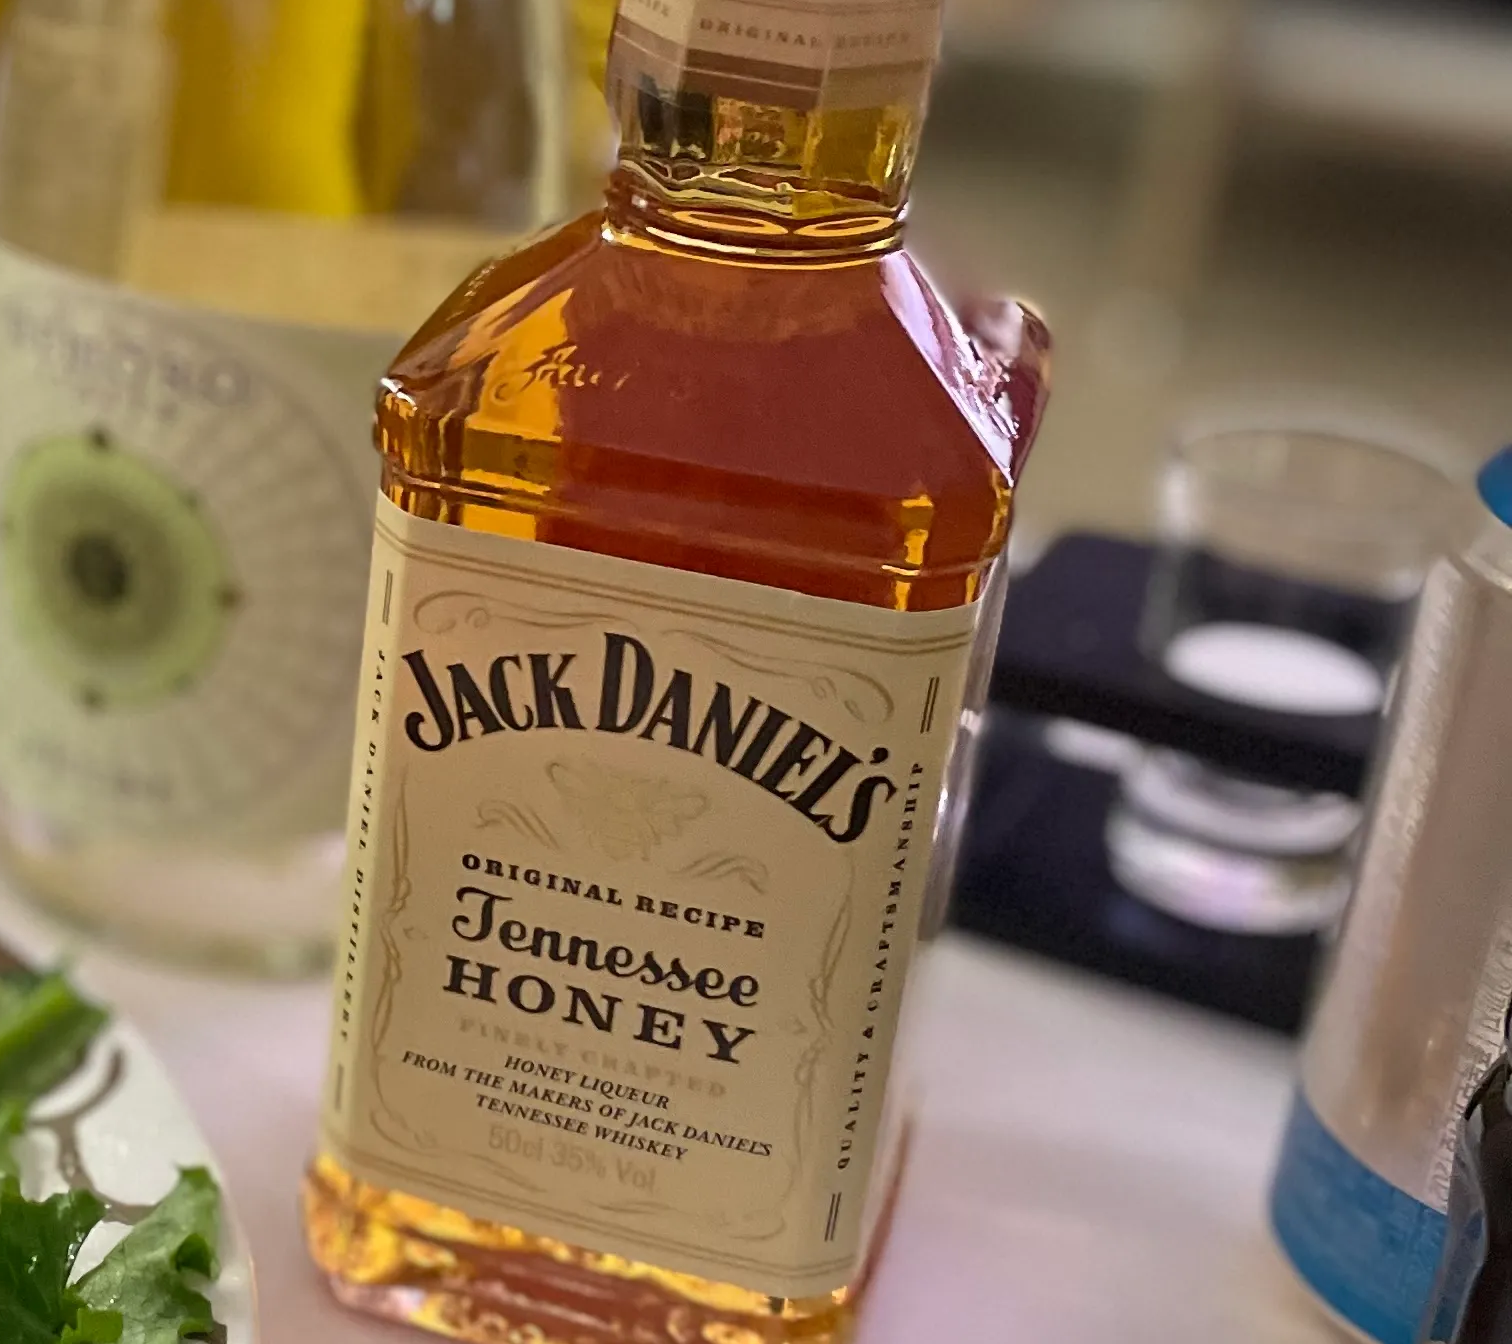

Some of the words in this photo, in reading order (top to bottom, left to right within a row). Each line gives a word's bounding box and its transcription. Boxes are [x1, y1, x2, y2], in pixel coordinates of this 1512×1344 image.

[402, 648, 587, 752] JACK
[594, 630, 898, 845] DANIEL'S
[461, 853, 622, 906] ORIGINAL
[634, 893, 765, 939] RECIPE
[451, 885, 760, 1008] Tennessee
[441, 953, 756, 1066] HONEY
[401, 1049, 457, 1078] FROM
[463, 1067, 504, 1091] THE
[507, 1080, 593, 1113] MAKERS
[597, 1103, 627, 1121] OF
[624, 1111, 681, 1137] JACK
[474, 1093, 588, 1137] TENNESSEE
[593, 1124, 689, 1162] WHISKEY
[503, 1054, 576, 1086] HONEY
[578, 1074, 670, 1110] LIQUEUR
[836, 1051, 871, 1171] QUALITY
